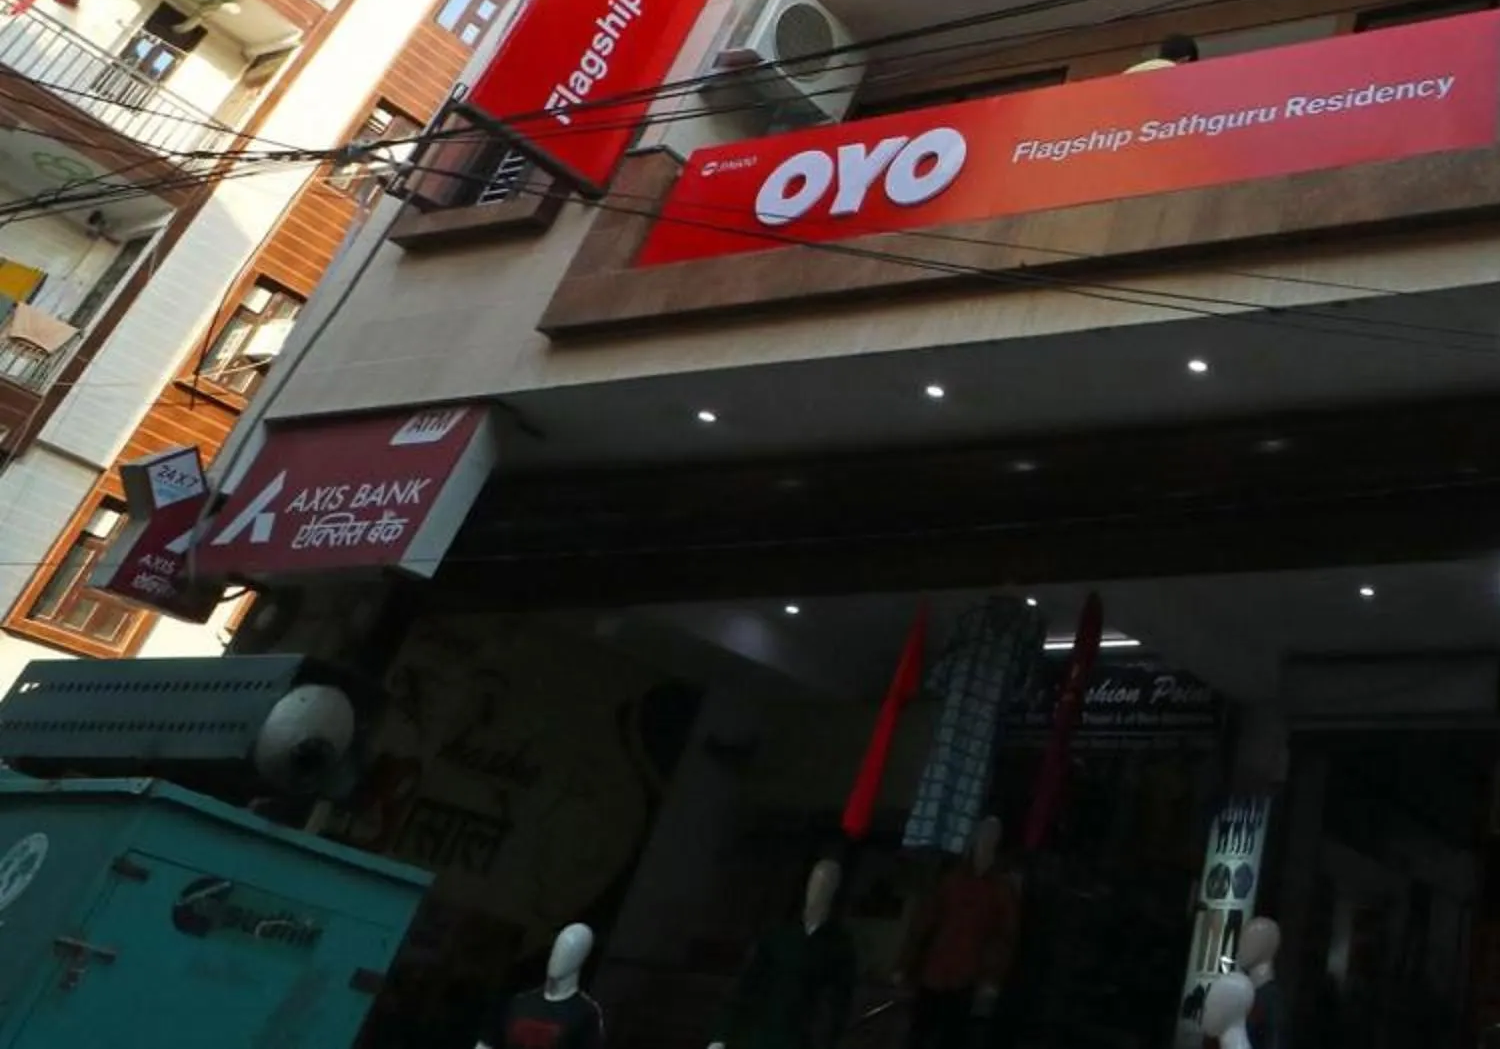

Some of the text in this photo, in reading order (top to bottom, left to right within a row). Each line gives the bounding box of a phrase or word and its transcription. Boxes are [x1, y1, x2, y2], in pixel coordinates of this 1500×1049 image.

[1012, 73, 1455, 164] Flagship Sathguru Residency
[754, 126, 967, 225] OYO
[284, 478, 432, 513] AXIS BANK
[138, 554, 176, 575] AXIS
